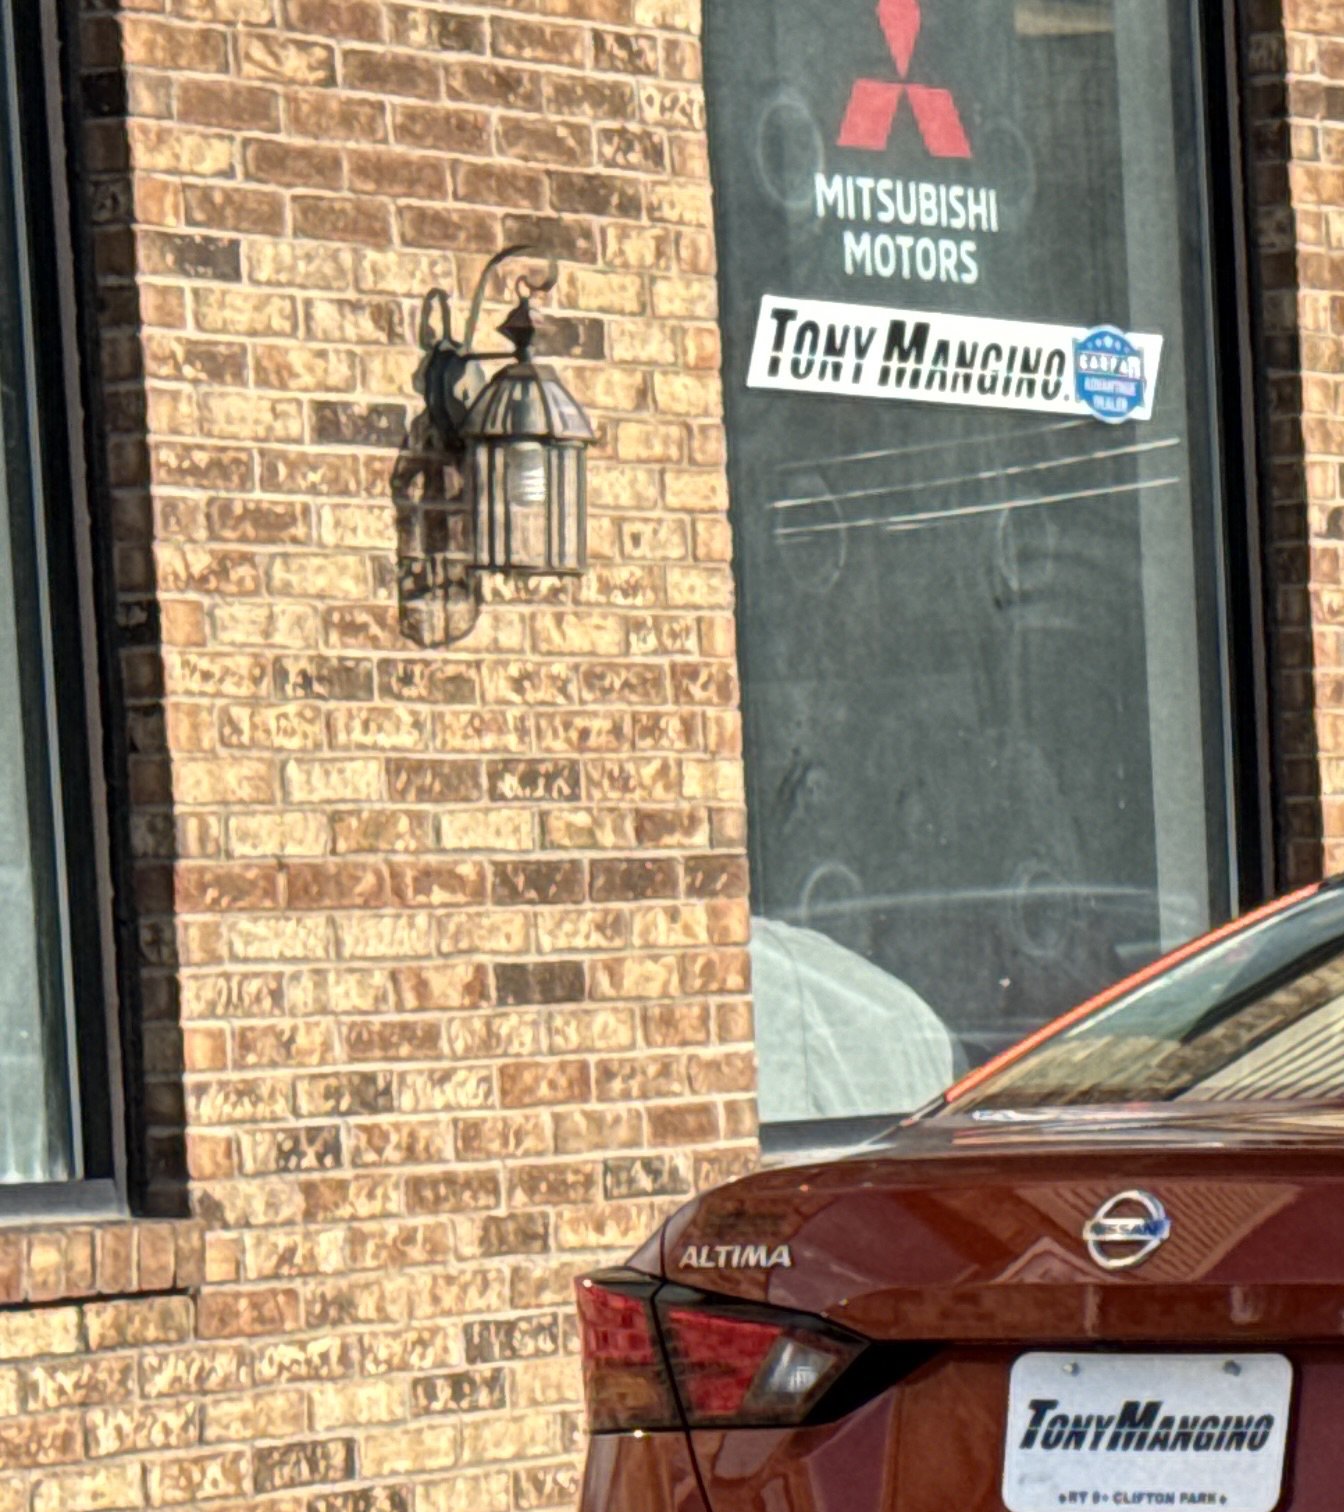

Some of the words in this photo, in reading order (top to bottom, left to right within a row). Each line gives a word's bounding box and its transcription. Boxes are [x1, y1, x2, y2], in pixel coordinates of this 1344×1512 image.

[815, 173, 999, 233] MITSUBISHI
[843, 231, 979, 285] MOTORS
[767, 308, 876, 384] TONY
[879, 320, 1067, 401] MANGINO
[678, 1244, 793, 1269] ALTIMA
[1112, 1490, 1176, 1505] CLIFTON
[1179, 1490, 1217, 1505] PARK
